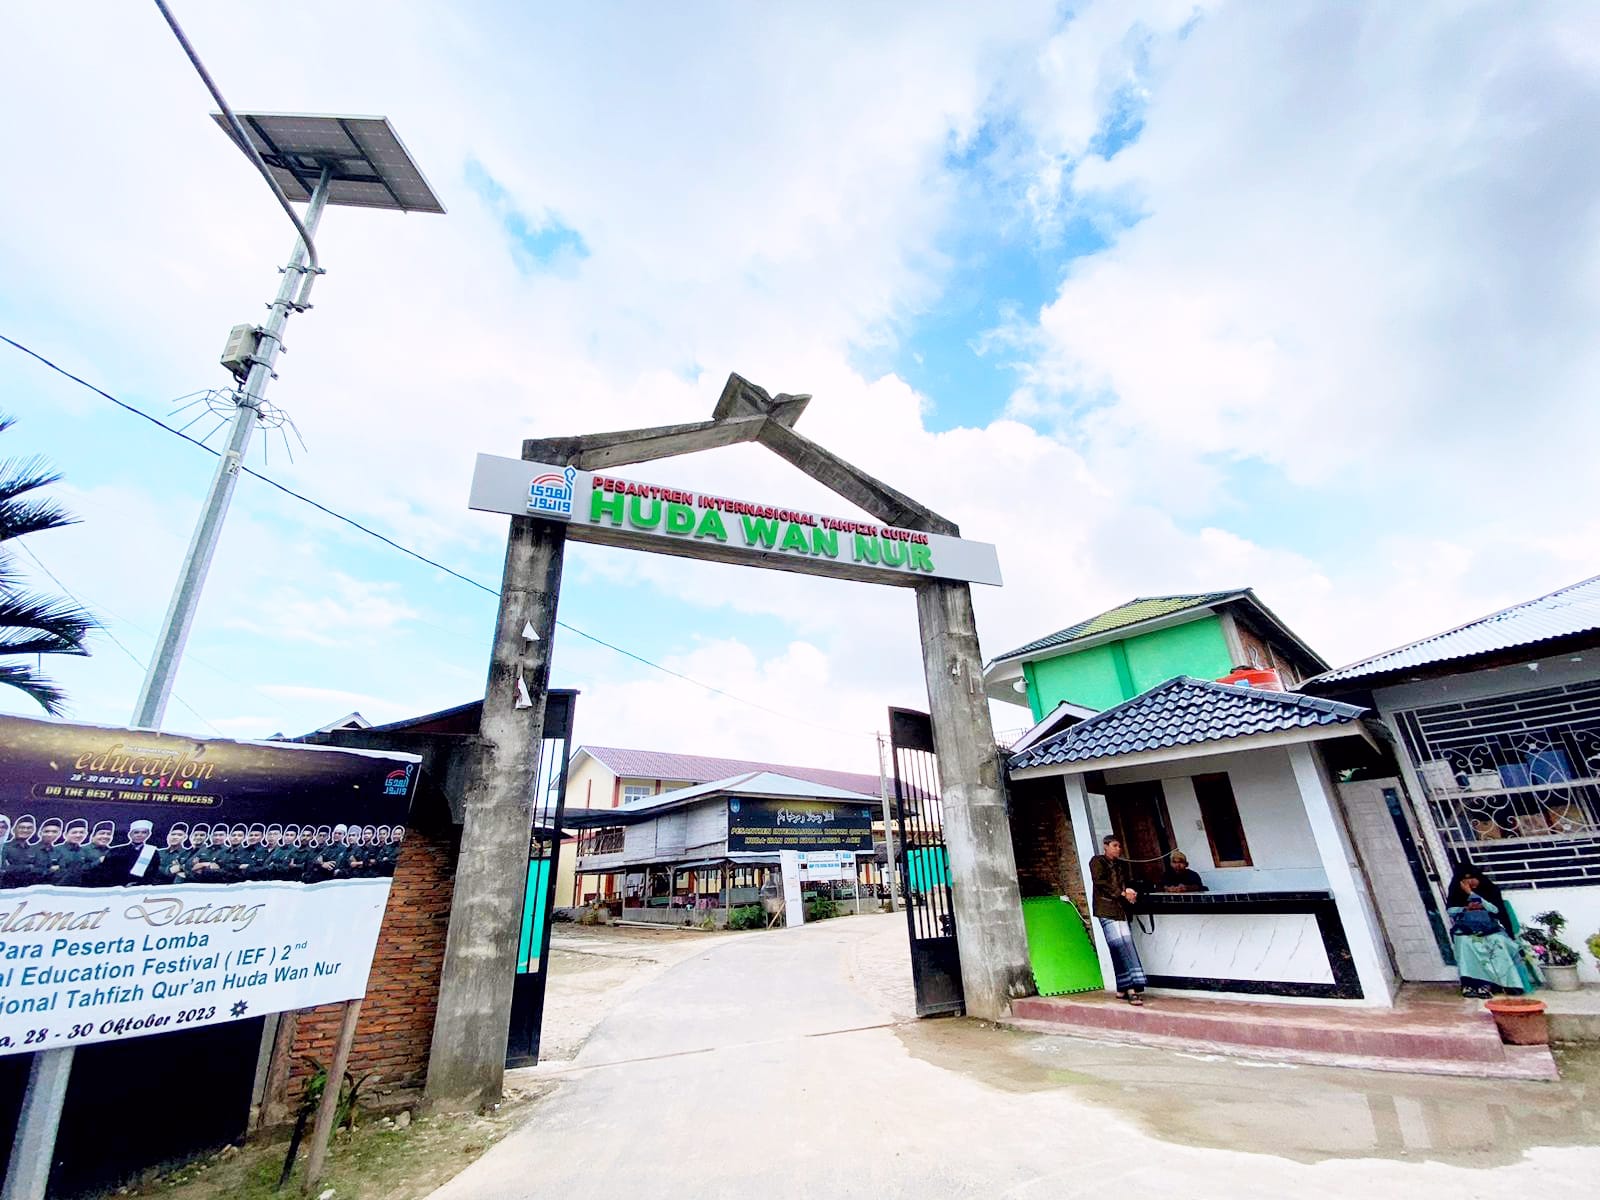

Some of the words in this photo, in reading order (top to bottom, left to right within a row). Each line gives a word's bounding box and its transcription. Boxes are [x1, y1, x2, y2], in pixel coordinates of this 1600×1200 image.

[592, 476, 693, 507] PESANTREN
[698, 495, 817, 527] INTERNASIONAL
[821, 517, 878, 537] TAHFIZH
[590, 490, 728, 541] HUDA
[740, 514, 839, 558] WAN
[852, 534, 935, 573] NUR
[45, 786, 61, 796] DO
[64, 787, 84, 797] THE
[118, 791, 149, 801] TRUST
[152, 793, 170, 803] THE
[171, 794, 214, 805] PROCESS
[99, 776, 115, 784] OKT
[124, 897, 266, 933] Datang
[52, 938, 135, 957] Peserta
[142, 932, 209, 952] Lomba
[20, 961, 135, 986] Education
[142, 953, 220, 976] Festival
[66, 984, 144, 1009] Tahfizh
[152, 978, 216, 999] Qur'an
[222, 970, 268, 990] Huda
[274, 966, 309, 983] Wan
[313, 961, 341, 977] Nur
[24, 1027, 49, 1045] 28
[67, 1023, 95, 1040] 30
[100, 1013, 171, 1036] Oktober
[176, 1006, 216, 1024] 2023
